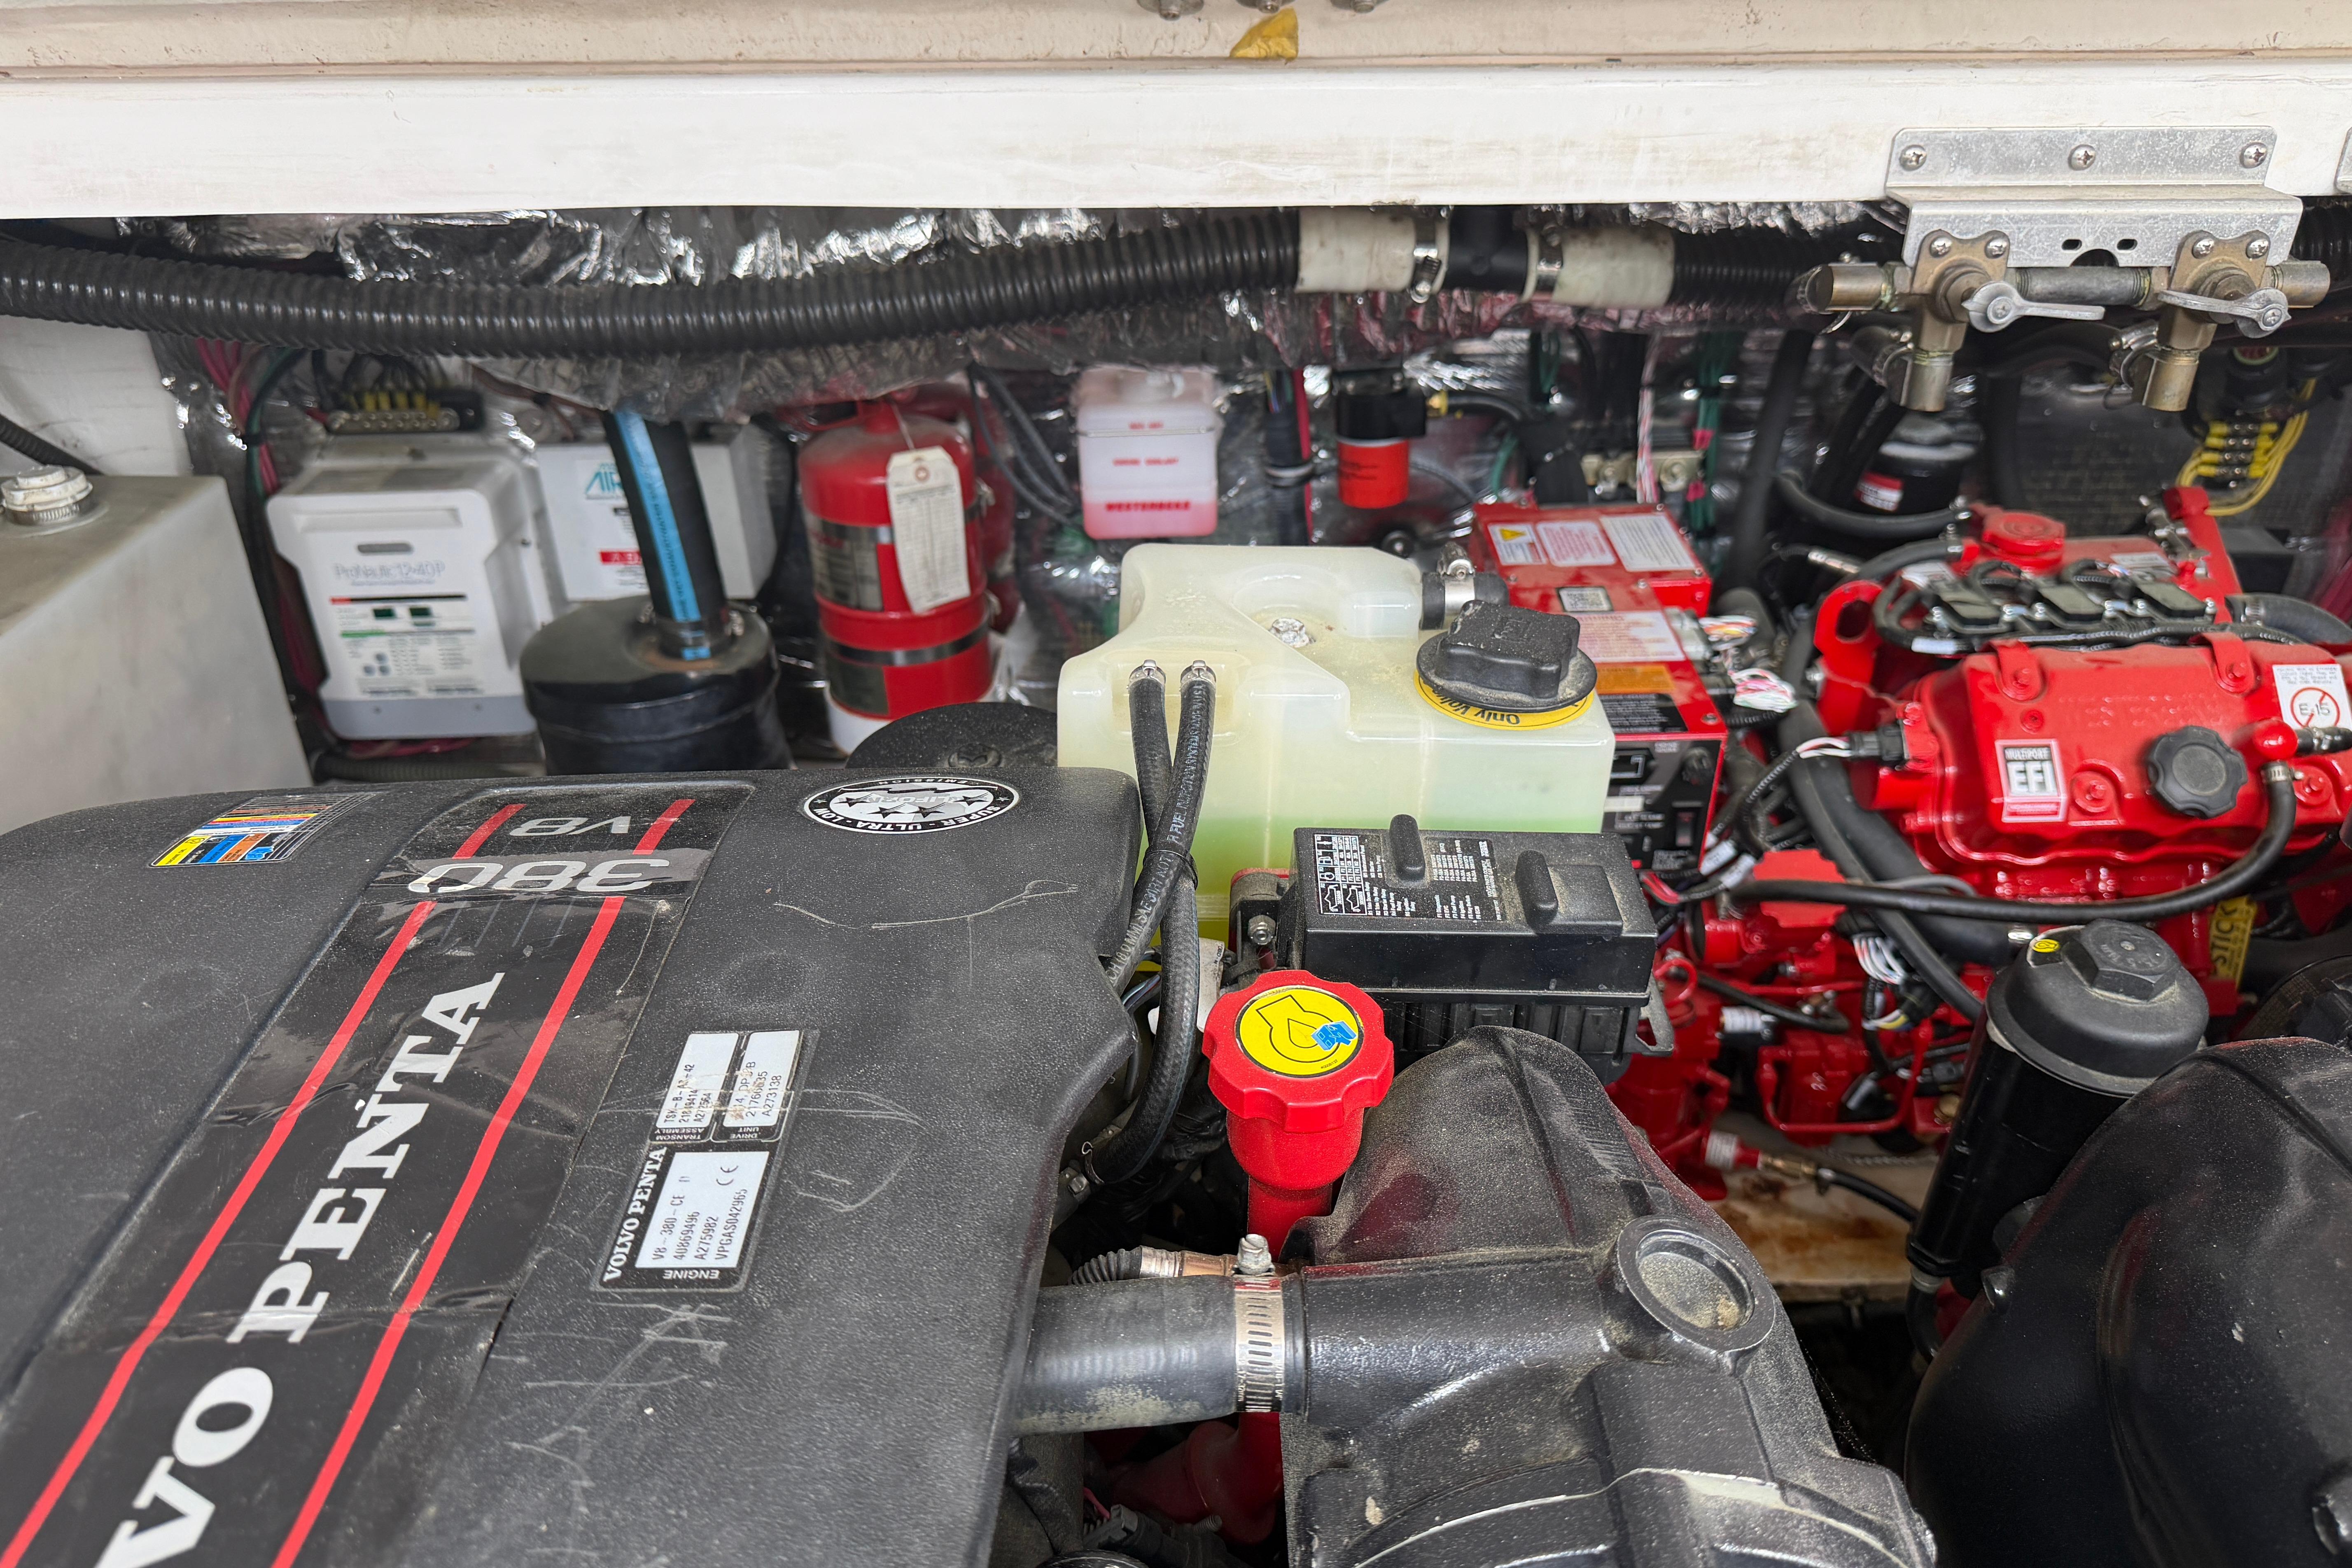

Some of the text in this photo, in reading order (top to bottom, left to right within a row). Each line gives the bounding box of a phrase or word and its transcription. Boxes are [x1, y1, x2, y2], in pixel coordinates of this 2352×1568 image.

[1477, 709, 1520, 725] Only
[2004, 747, 2051, 761] MULTIPORT
[2007, 761, 2058, 796] EFI
[509, 816, 631, 836] V8
[813, 806, 1001, 831] SUPER ULTRA LOW
[1170, 808, 1187, 835] FUEL
[408, 859, 670, 893] 380
[1156, 855, 1174, 878] NOT
[761, 1075, 782, 1117] A273138
[226, 972, 505, 1343] PENTA
[602, 1146, 668, 1283] VOLVO PENTA
[714, 1188, 748, 1260] VPGAS042965
[673, 1211, 700, 1260] 40869496
[694, 1216, 719, 1260] A275982
[663, 1270, 721, 1279] ENGINE
